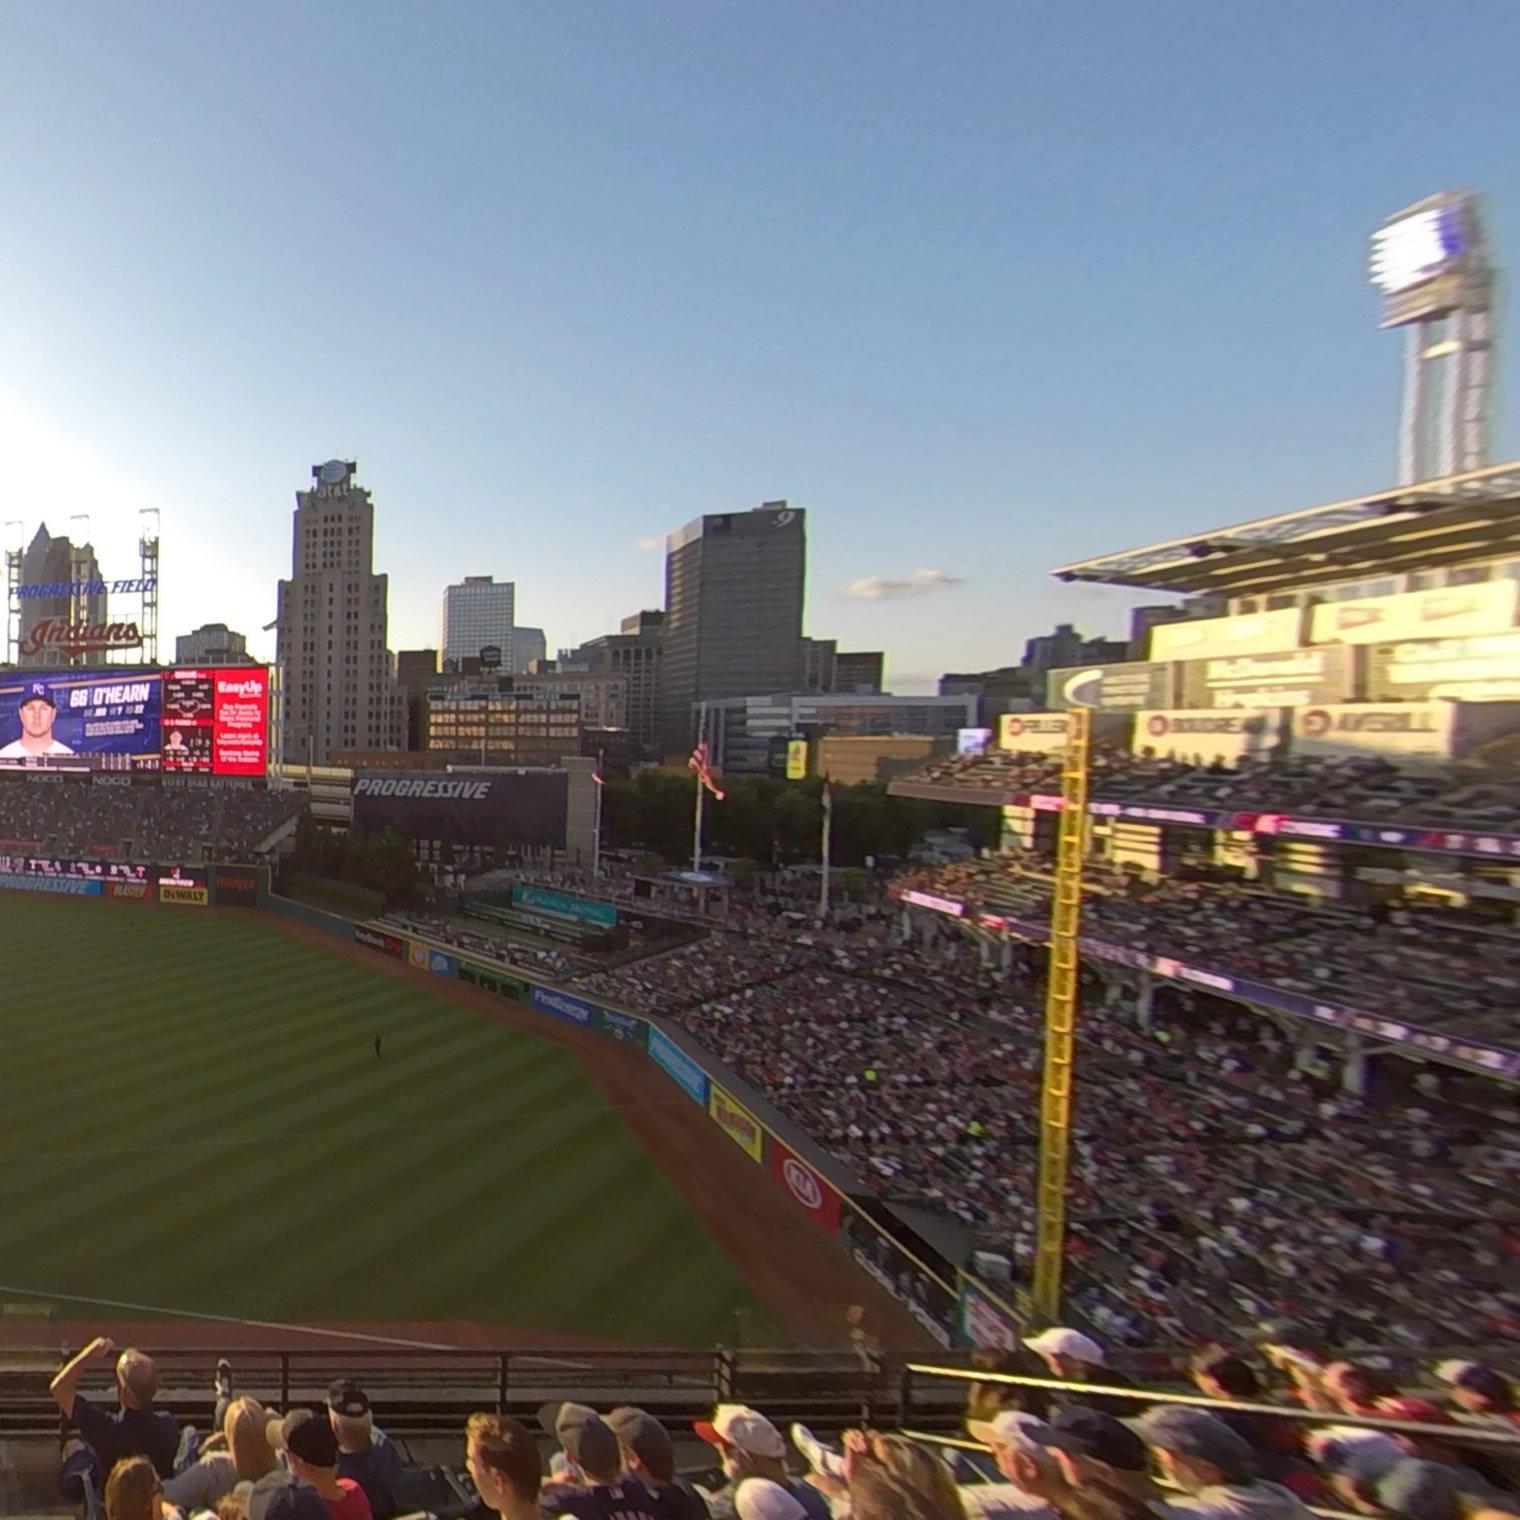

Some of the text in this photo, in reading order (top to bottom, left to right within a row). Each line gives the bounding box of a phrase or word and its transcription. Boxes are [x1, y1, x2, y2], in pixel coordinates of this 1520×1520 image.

[10, 578, 158, 600] PROGRESSIVE FIELD
[19, 618, 144, 657] Indians
[70, 688, 88, 708] 66
[93, 682, 150, 705] O'HEARN
[217, 680, 263, 696] EasyUp
[26, 774, 64, 784] NOCO
[92, 775, 132, 787] NOCO
[353, 778, 491, 801] PROGRESSIVE
